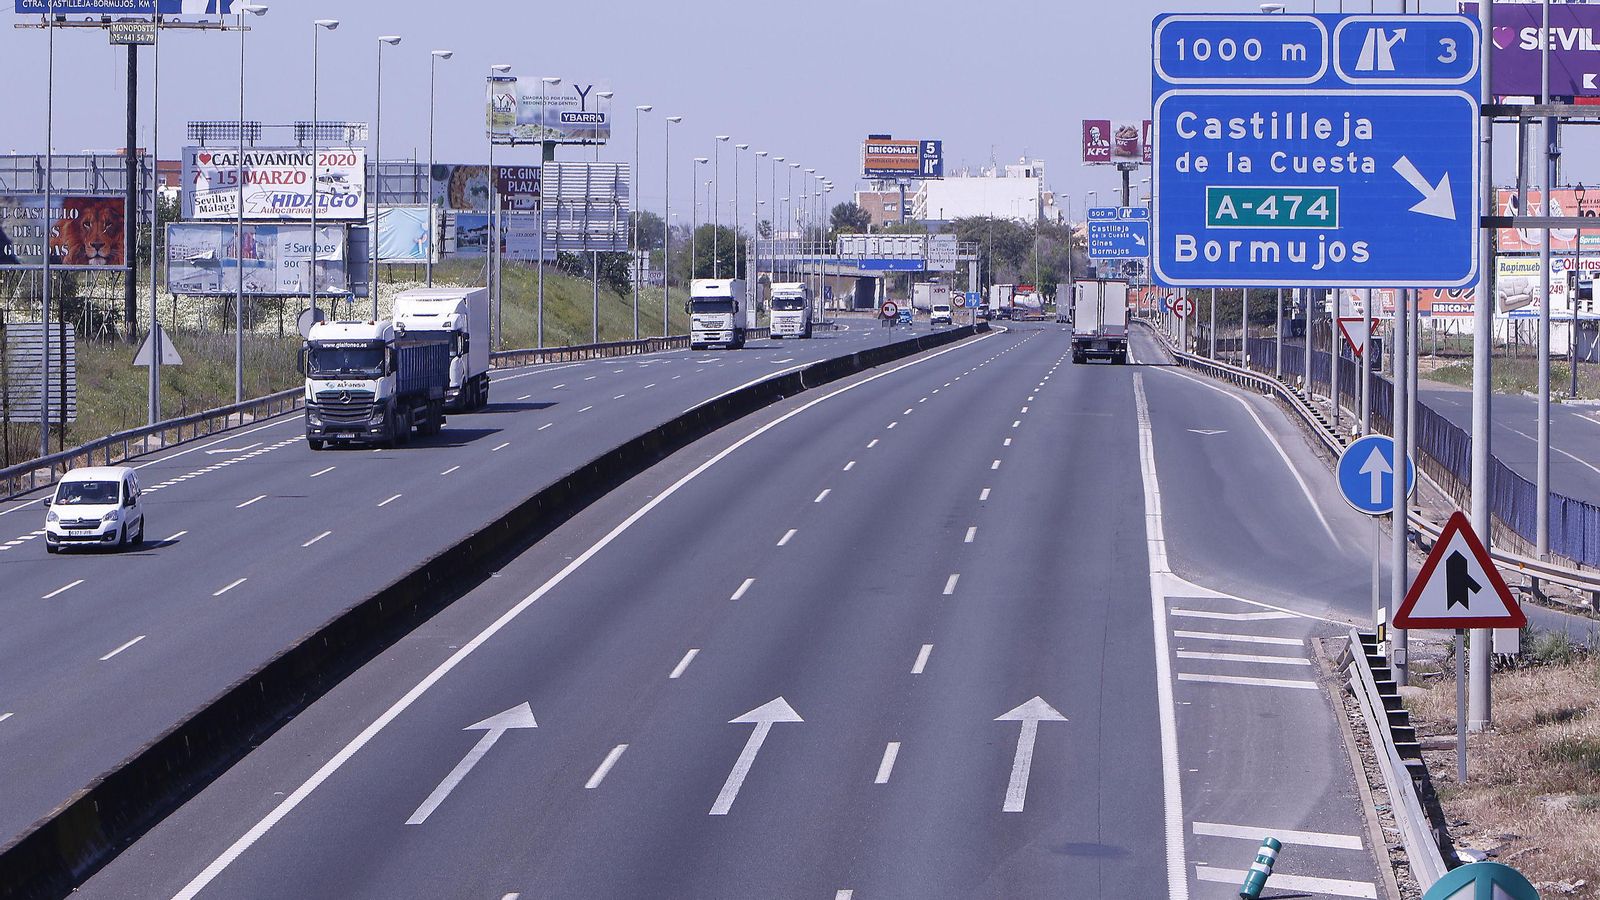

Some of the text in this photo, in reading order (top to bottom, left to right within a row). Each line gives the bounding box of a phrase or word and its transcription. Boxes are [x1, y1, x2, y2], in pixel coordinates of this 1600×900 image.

[112, 24, 154, 32] MONOPOSTE
[1176, 38, 1306, 61] 1000 m
[1437, 38, 1458, 63] 3
[563, 113, 603, 122] YBARRA
[1176, 111, 1373, 147] Castilleja
[868, 146, 917, 154] BRICOMART
[926, 142, 936, 154] 5
[1086, 148, 1109, 156] KFC
[318, 153, 357, 166] 2020
[1175, 151, 1376, 173] de la Cuesta
[191, 170, 202, 184] 7
[217, 170, 237, 184] 15
[242, 170, 306, 185] MARZO
[500, 167, 516, 179] P.C.
[508, 181, 541, 192] PLAZA
[194, 194, 236, 206] Sevilla y
[271, 193, 359, 208] HIDALGO
[0, 207, 79, 219] L CASTILLO
[198, 203, 236, 214] Málaga
[1215, 195, 1330, 220] A-474
[12, 226, 60, 237] DE LS
[1091, 225, 1130, 233] Castilleja
[4, 244, 70, 256] GUARAS
[1091, 248, 1130, 256] Bormujos
[1175, 234, 1370, 270] Bormujos
[1500, 262, 1540, 273] Rapimueb
[1433, 304, 1474, 312] BRICOMA
[1379, 644, 1384, 652] 2
